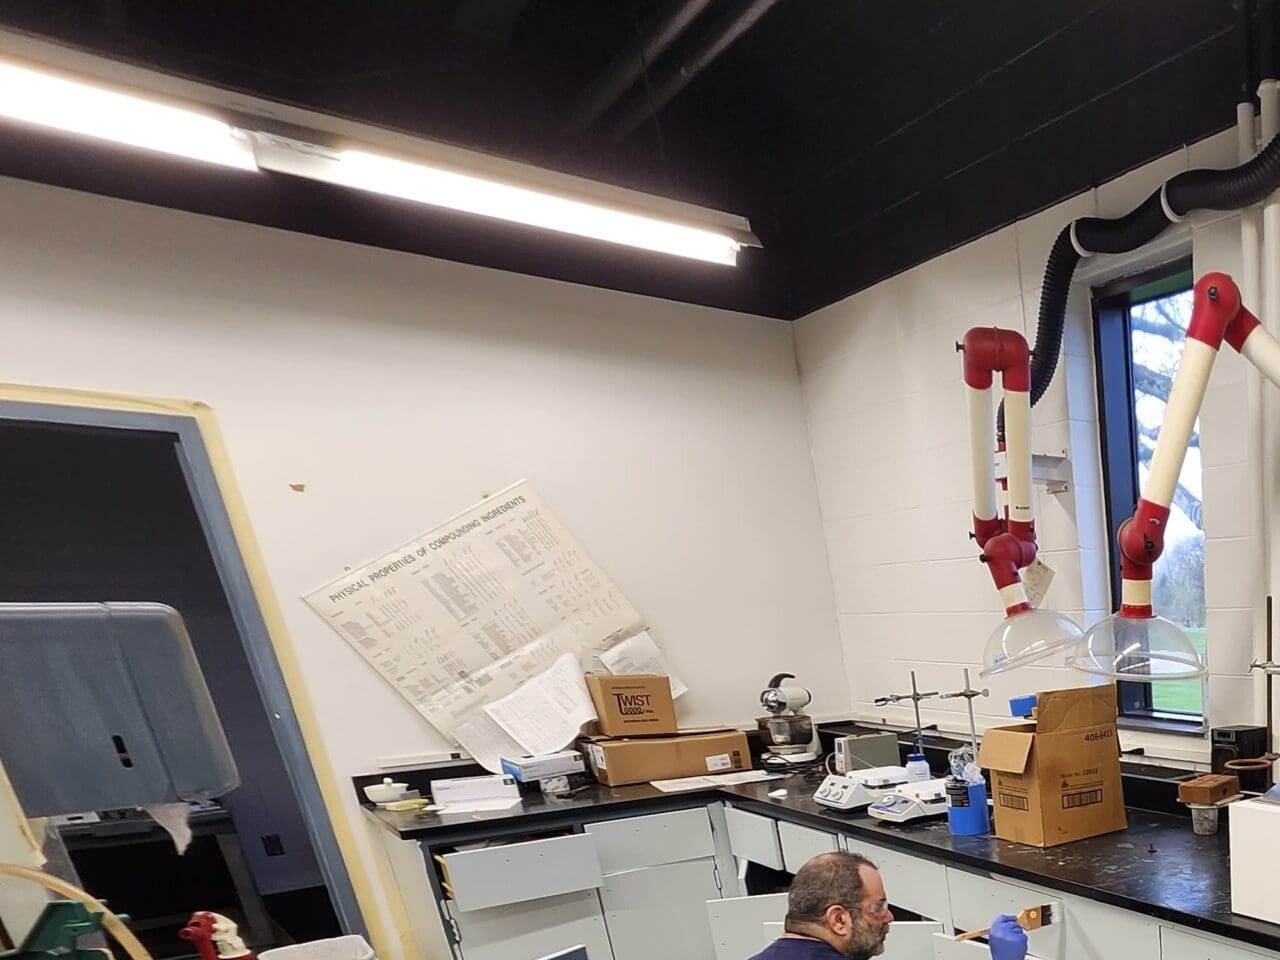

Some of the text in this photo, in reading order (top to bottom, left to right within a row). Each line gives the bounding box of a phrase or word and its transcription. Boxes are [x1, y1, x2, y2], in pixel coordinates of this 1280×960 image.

[328, 495, 526, 603] PHYSICAL PROPERTIES OF COMPOUNDING INGREDIENTS
[612, 693, 651, 715] TWIST
